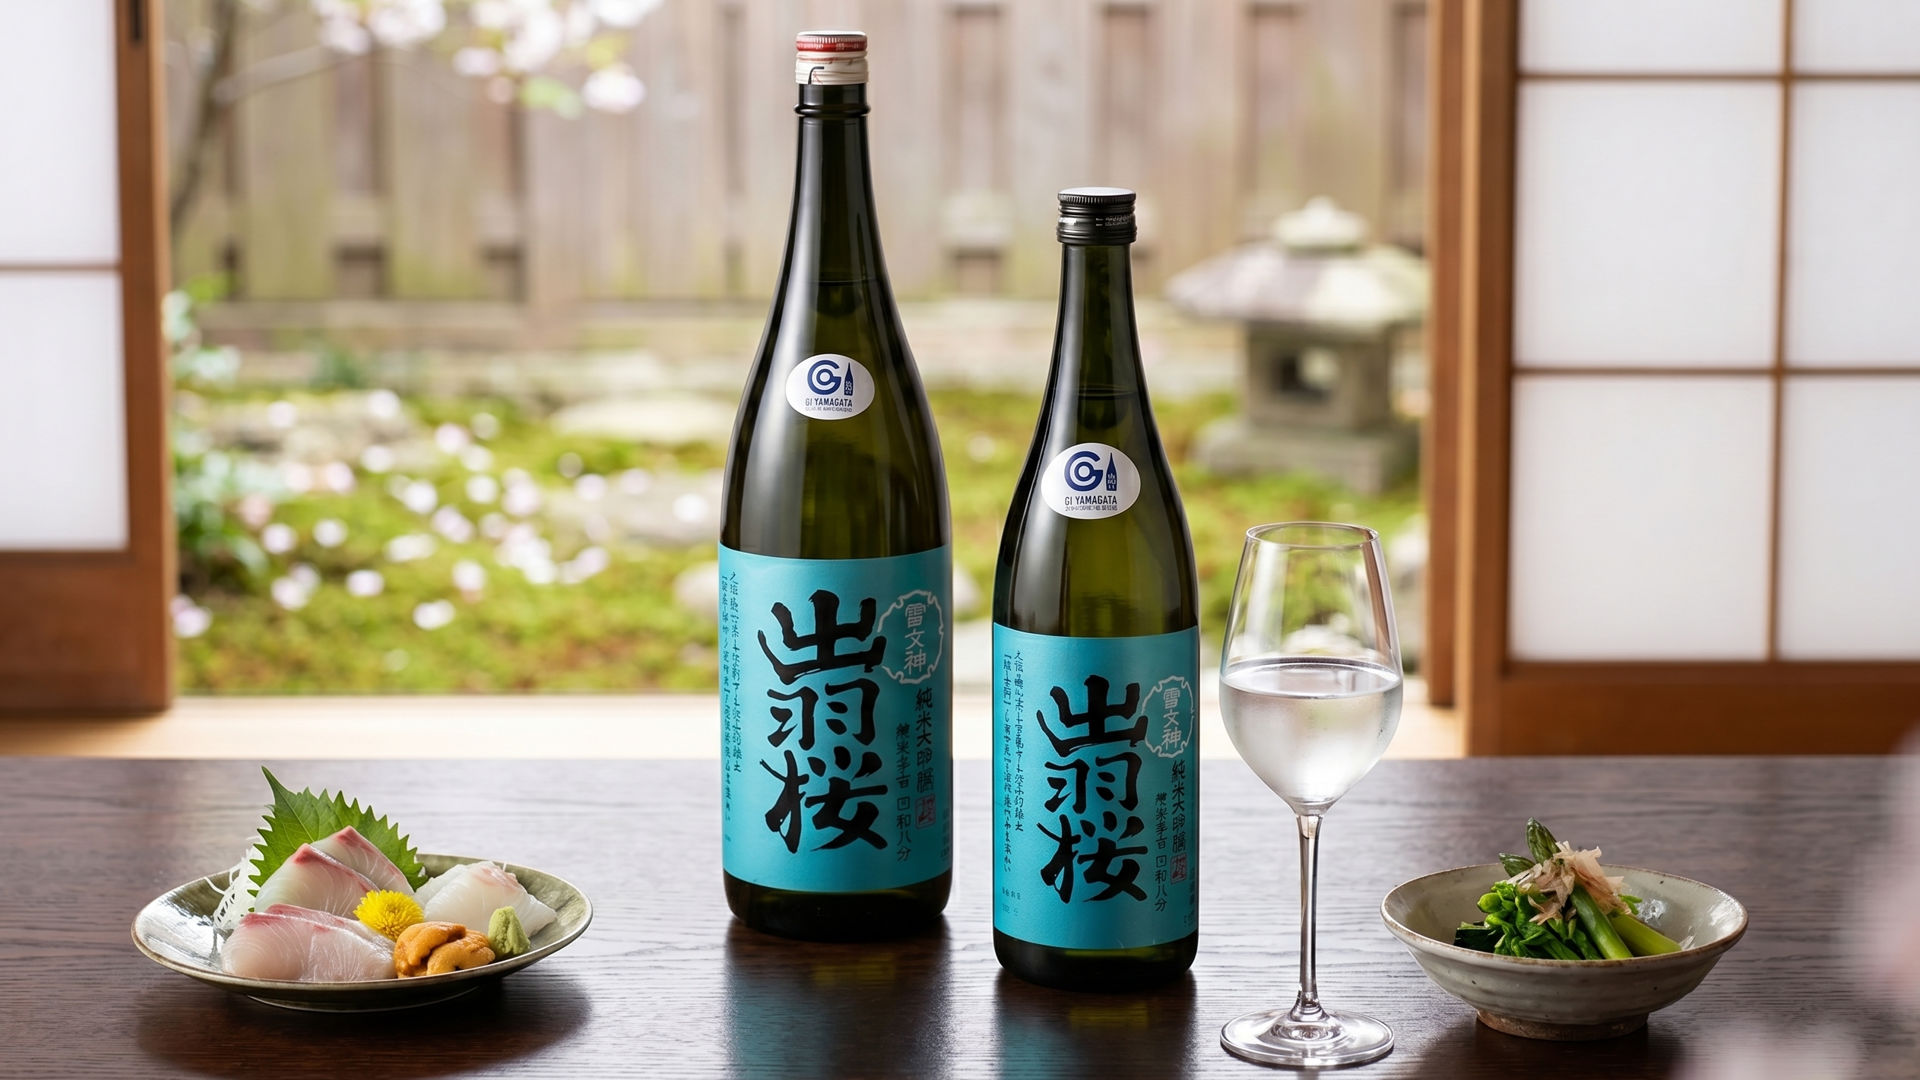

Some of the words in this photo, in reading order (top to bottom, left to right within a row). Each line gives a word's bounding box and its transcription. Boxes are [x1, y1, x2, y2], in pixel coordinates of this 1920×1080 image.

[815, 398, 853, 407] YAMAGATA
[1065, 497, 1073, 505] GI
[1075, 496, 1118, 504] YAMAGATA
[758, 589, 888, 855] 出羽桜
[1035, 674, 1148, 904] 出羽桜
